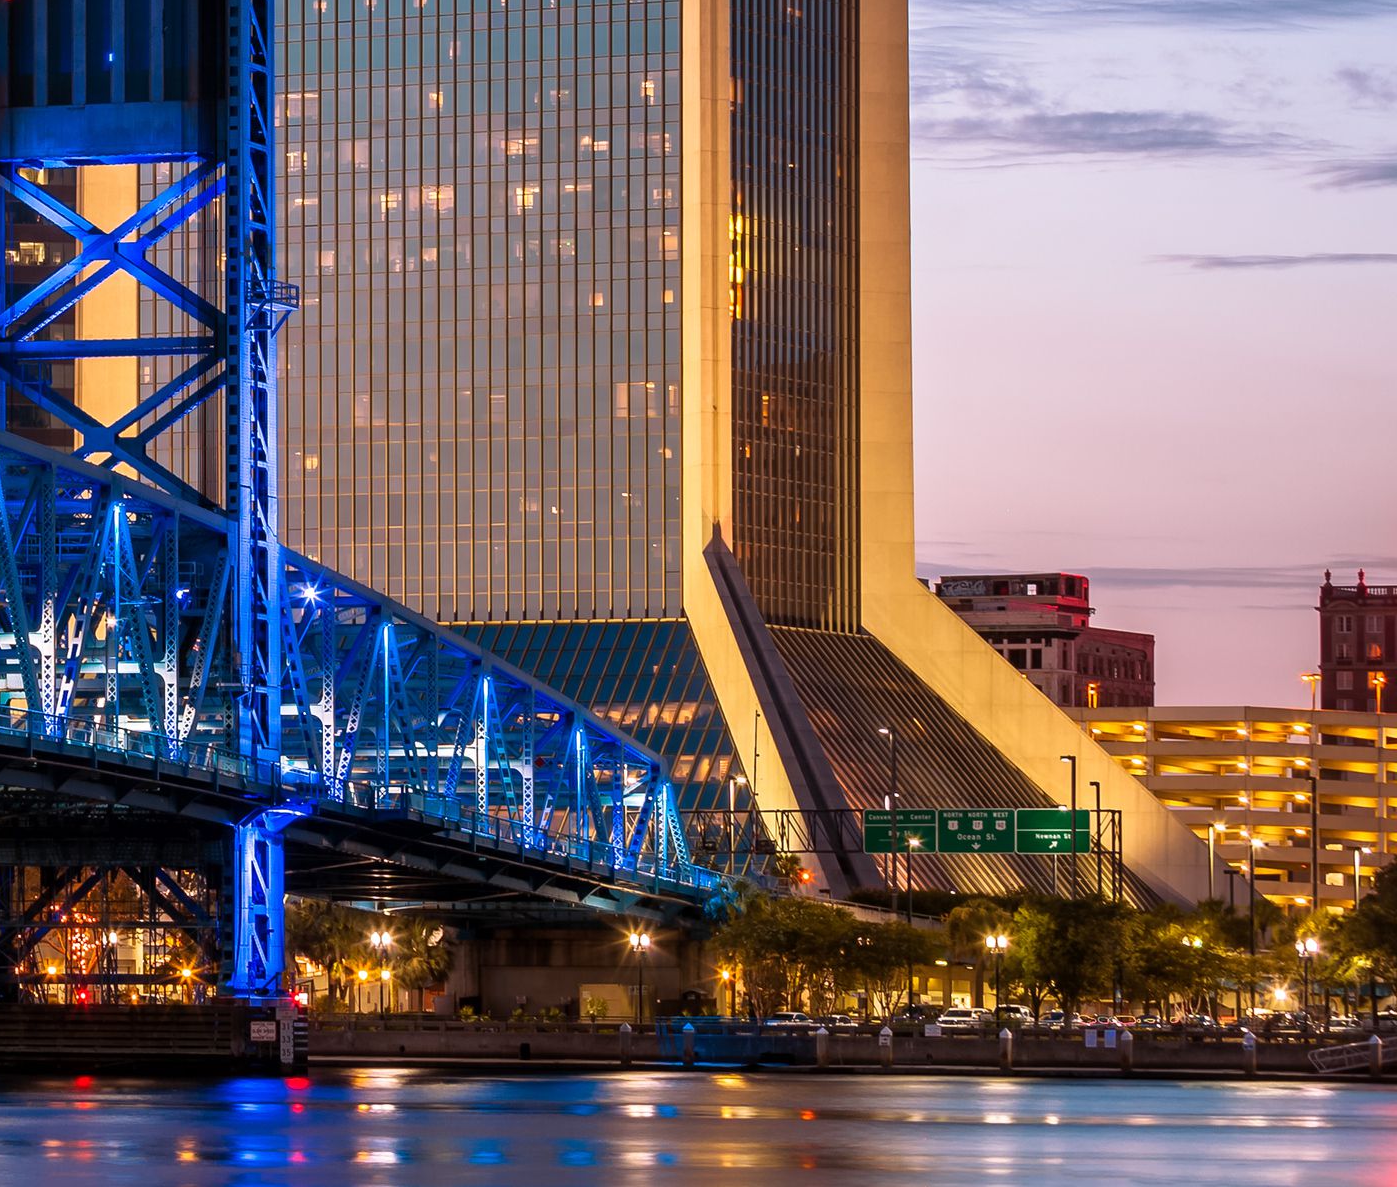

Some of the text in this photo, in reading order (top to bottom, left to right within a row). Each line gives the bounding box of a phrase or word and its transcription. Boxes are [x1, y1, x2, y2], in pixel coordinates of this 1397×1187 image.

[956, 833, 997, 841] Ocean St.
[281, 1022, 291, 1030] 31
[281, 1035, 291, 1043] 33
[281, 1048, 291, 1056] 35
